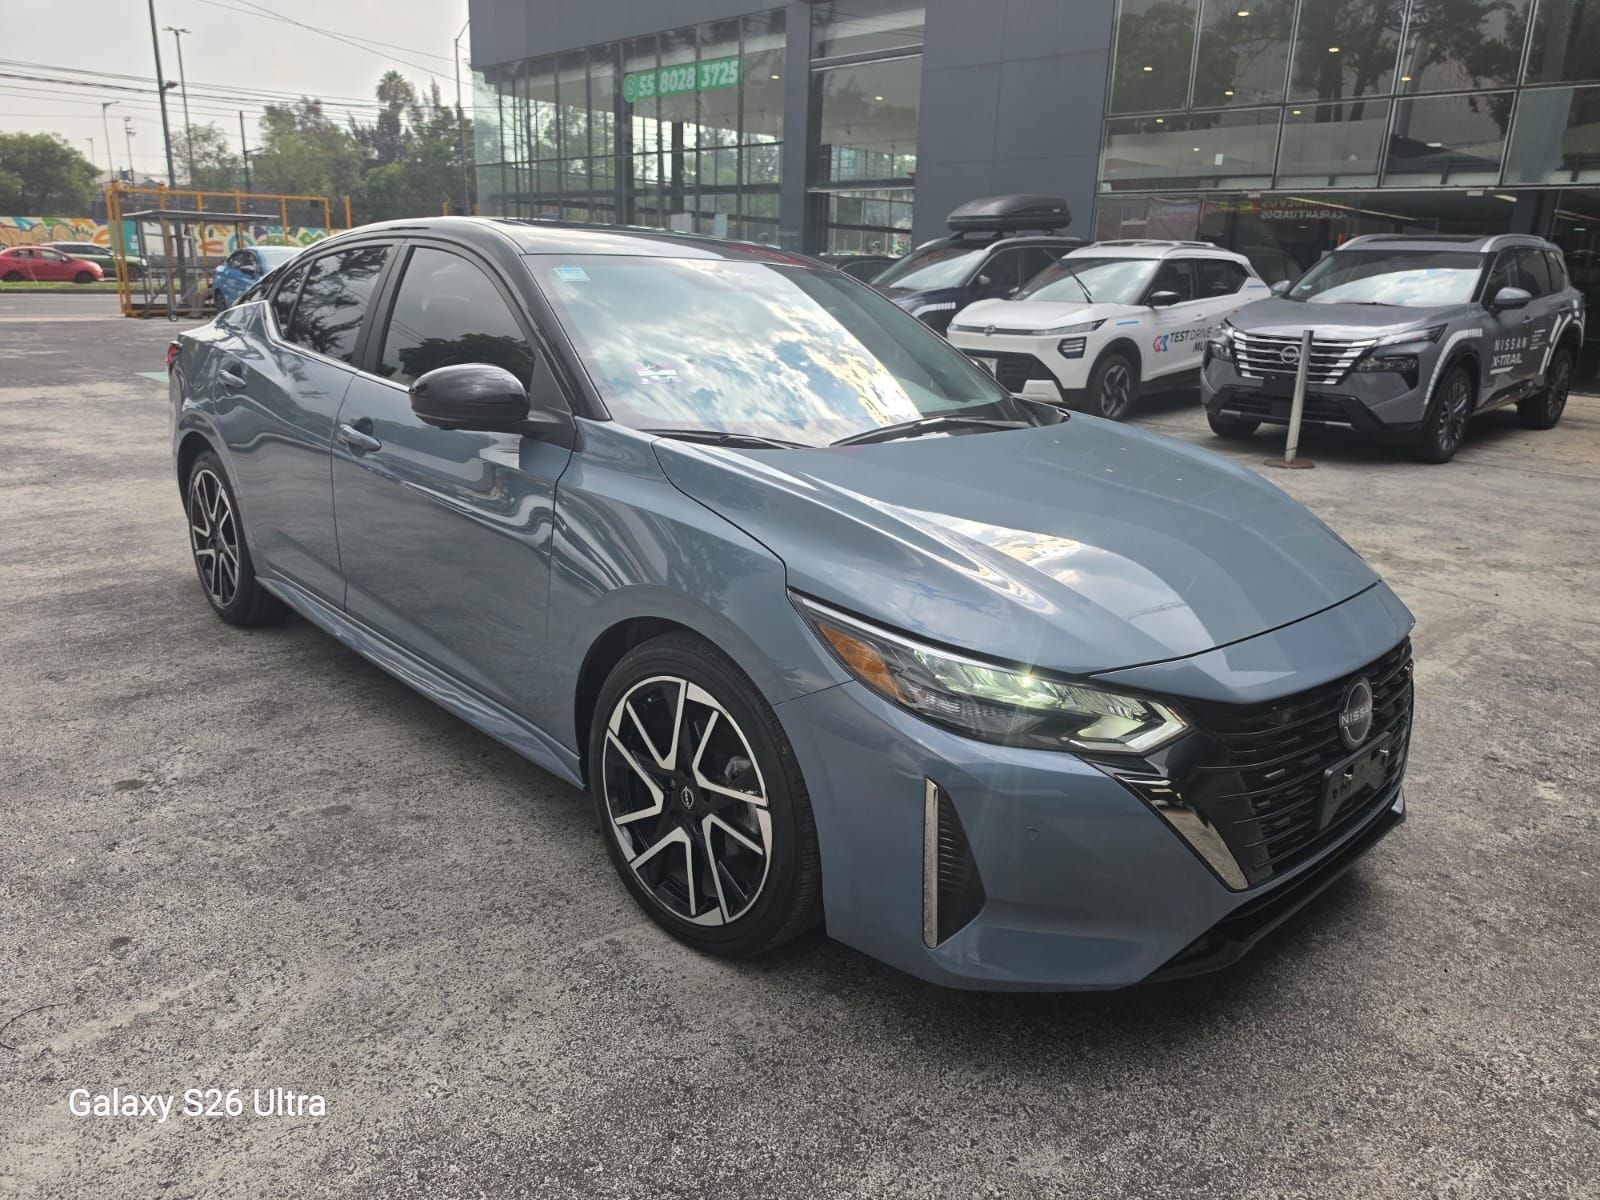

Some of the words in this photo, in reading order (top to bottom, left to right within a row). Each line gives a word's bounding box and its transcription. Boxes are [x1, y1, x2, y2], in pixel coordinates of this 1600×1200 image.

[638, 74, 656, 96] 55
[660, 67, 697, 93] 8028
[701, 60, 739, 87] 3725
[1170, 329, 1190, 343] TEST
[1494, 336, 1528, 351] NISSAN
[1491, 353, 1523, 368] X-TRAIL
